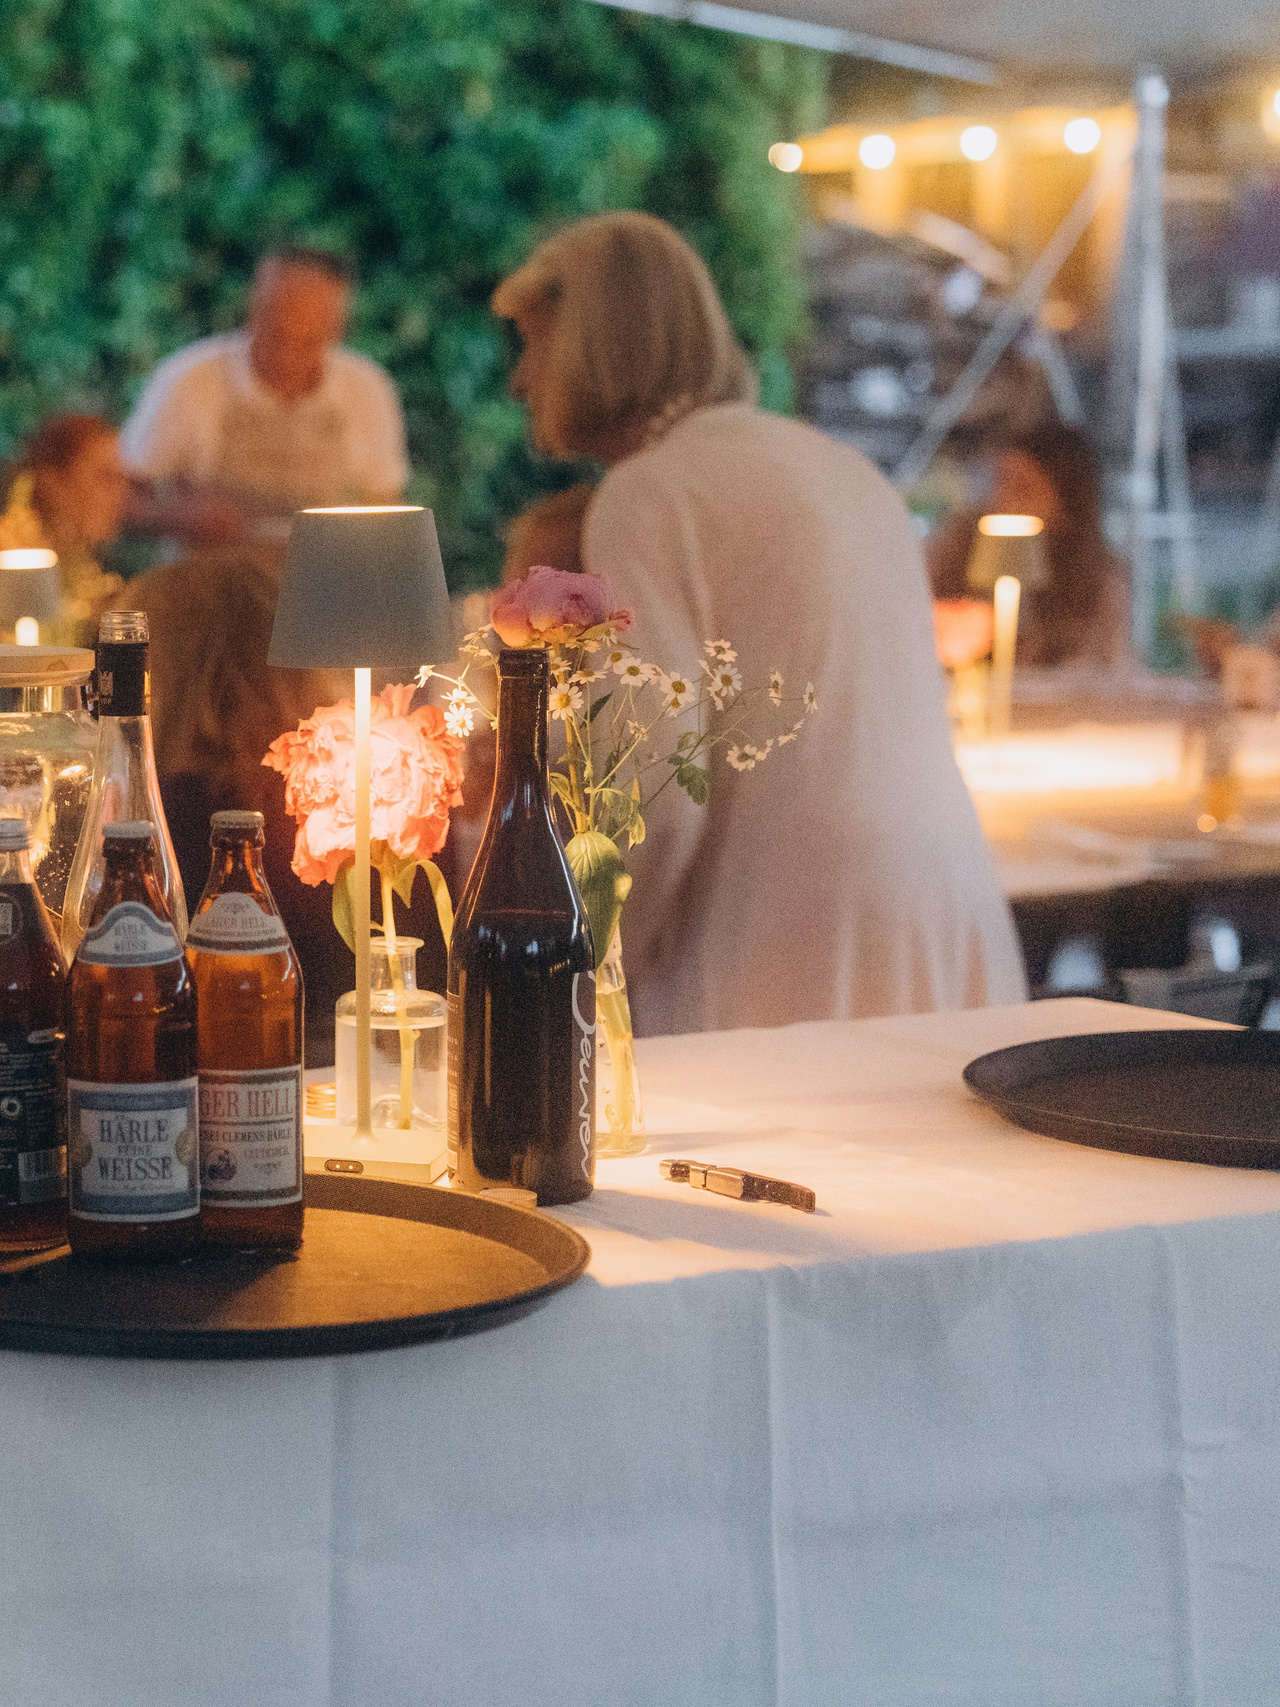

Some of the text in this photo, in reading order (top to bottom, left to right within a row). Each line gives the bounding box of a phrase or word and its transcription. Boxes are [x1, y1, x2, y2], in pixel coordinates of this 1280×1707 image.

[200, 1089, 240, 1118] GER
[247, 1087, 294, 1117] HELL
[99, 1114, 169, 1143] HÄRLE
[99, 1155, 173, 1181] WEISSE
